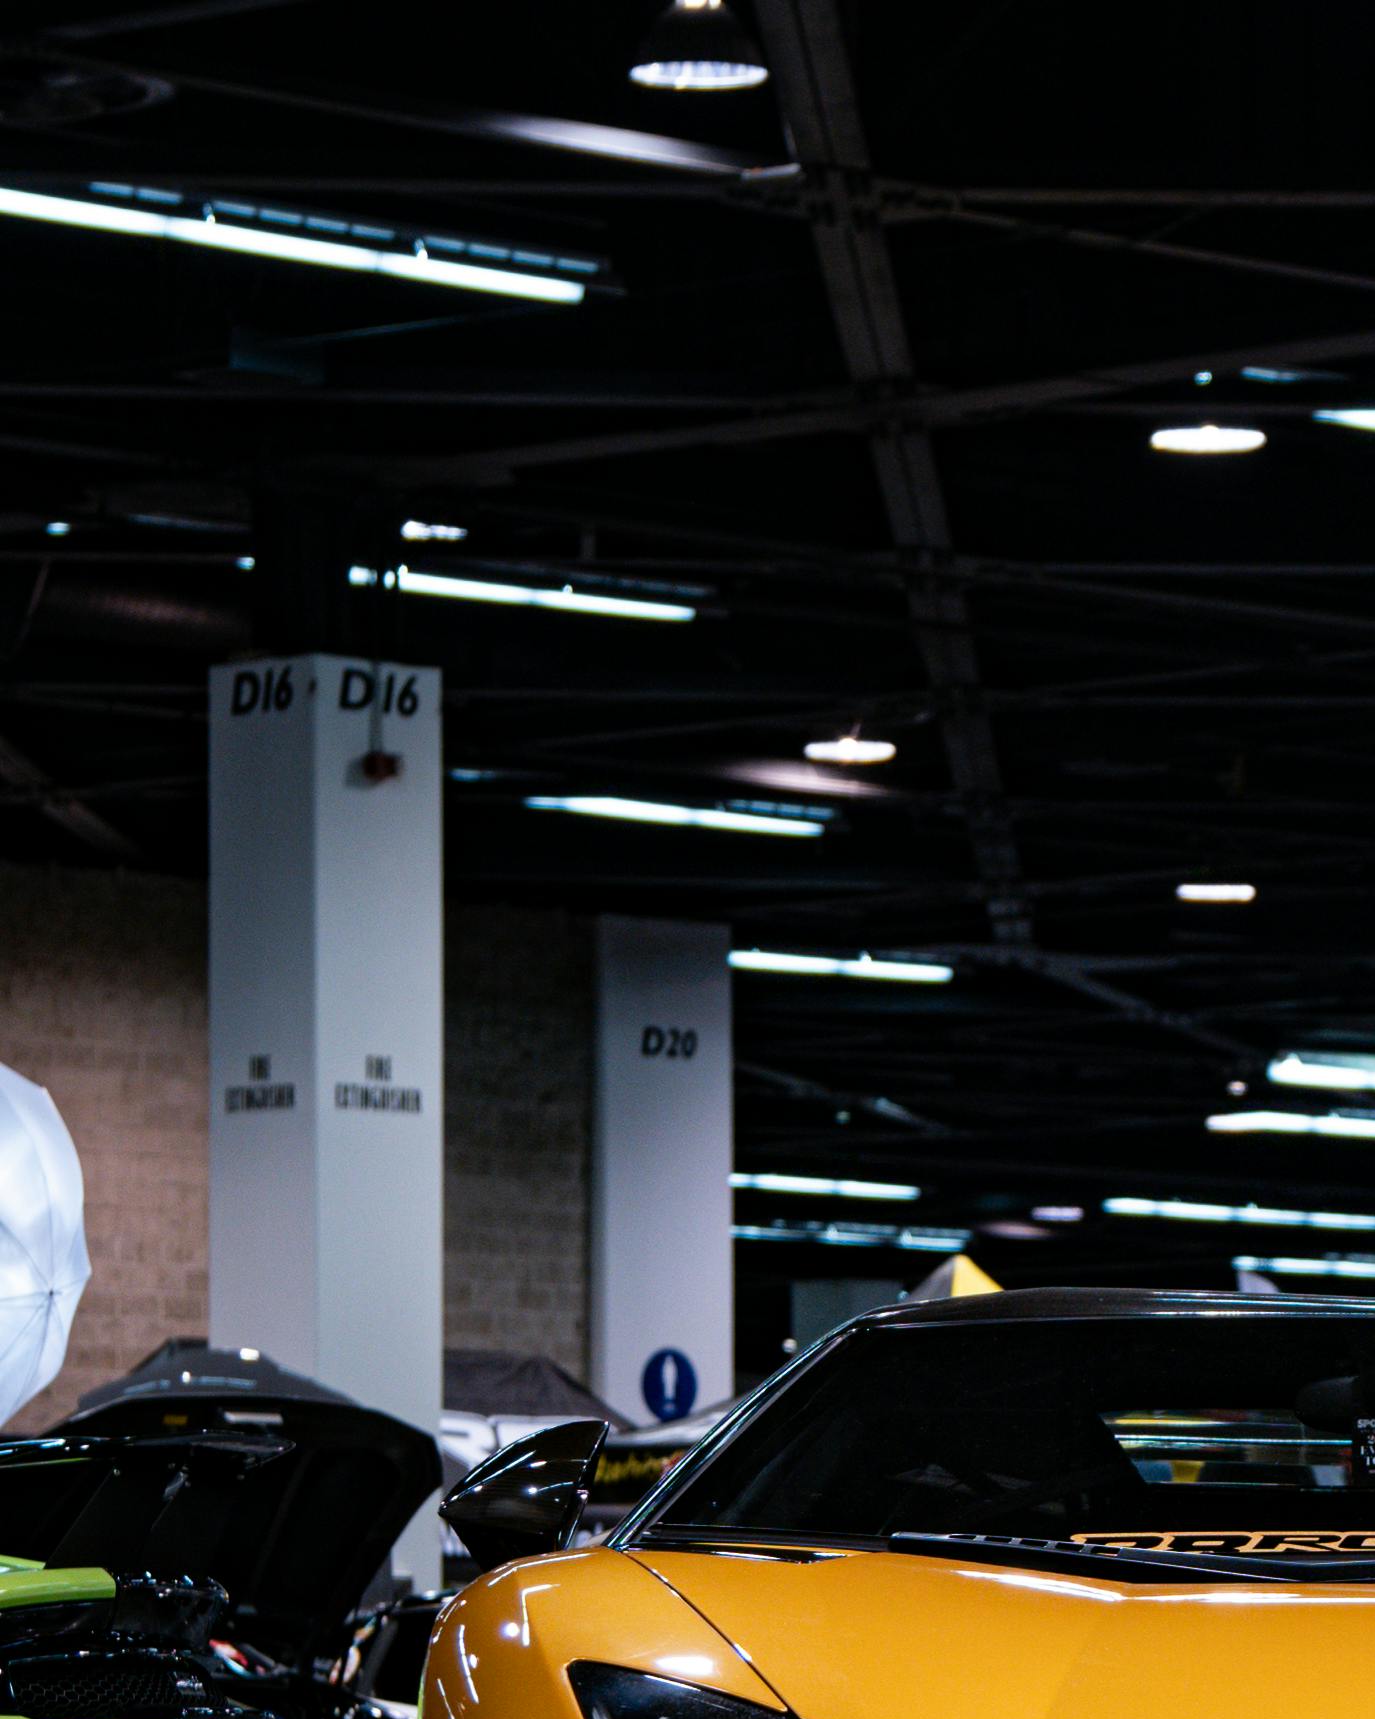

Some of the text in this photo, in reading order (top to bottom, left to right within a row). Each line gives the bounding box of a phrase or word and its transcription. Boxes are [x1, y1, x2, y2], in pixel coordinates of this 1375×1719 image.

[230, 667, 295, 716] D16
[339, 669, 419, 716] D16
[641, 1026, 698, 1058] D20
